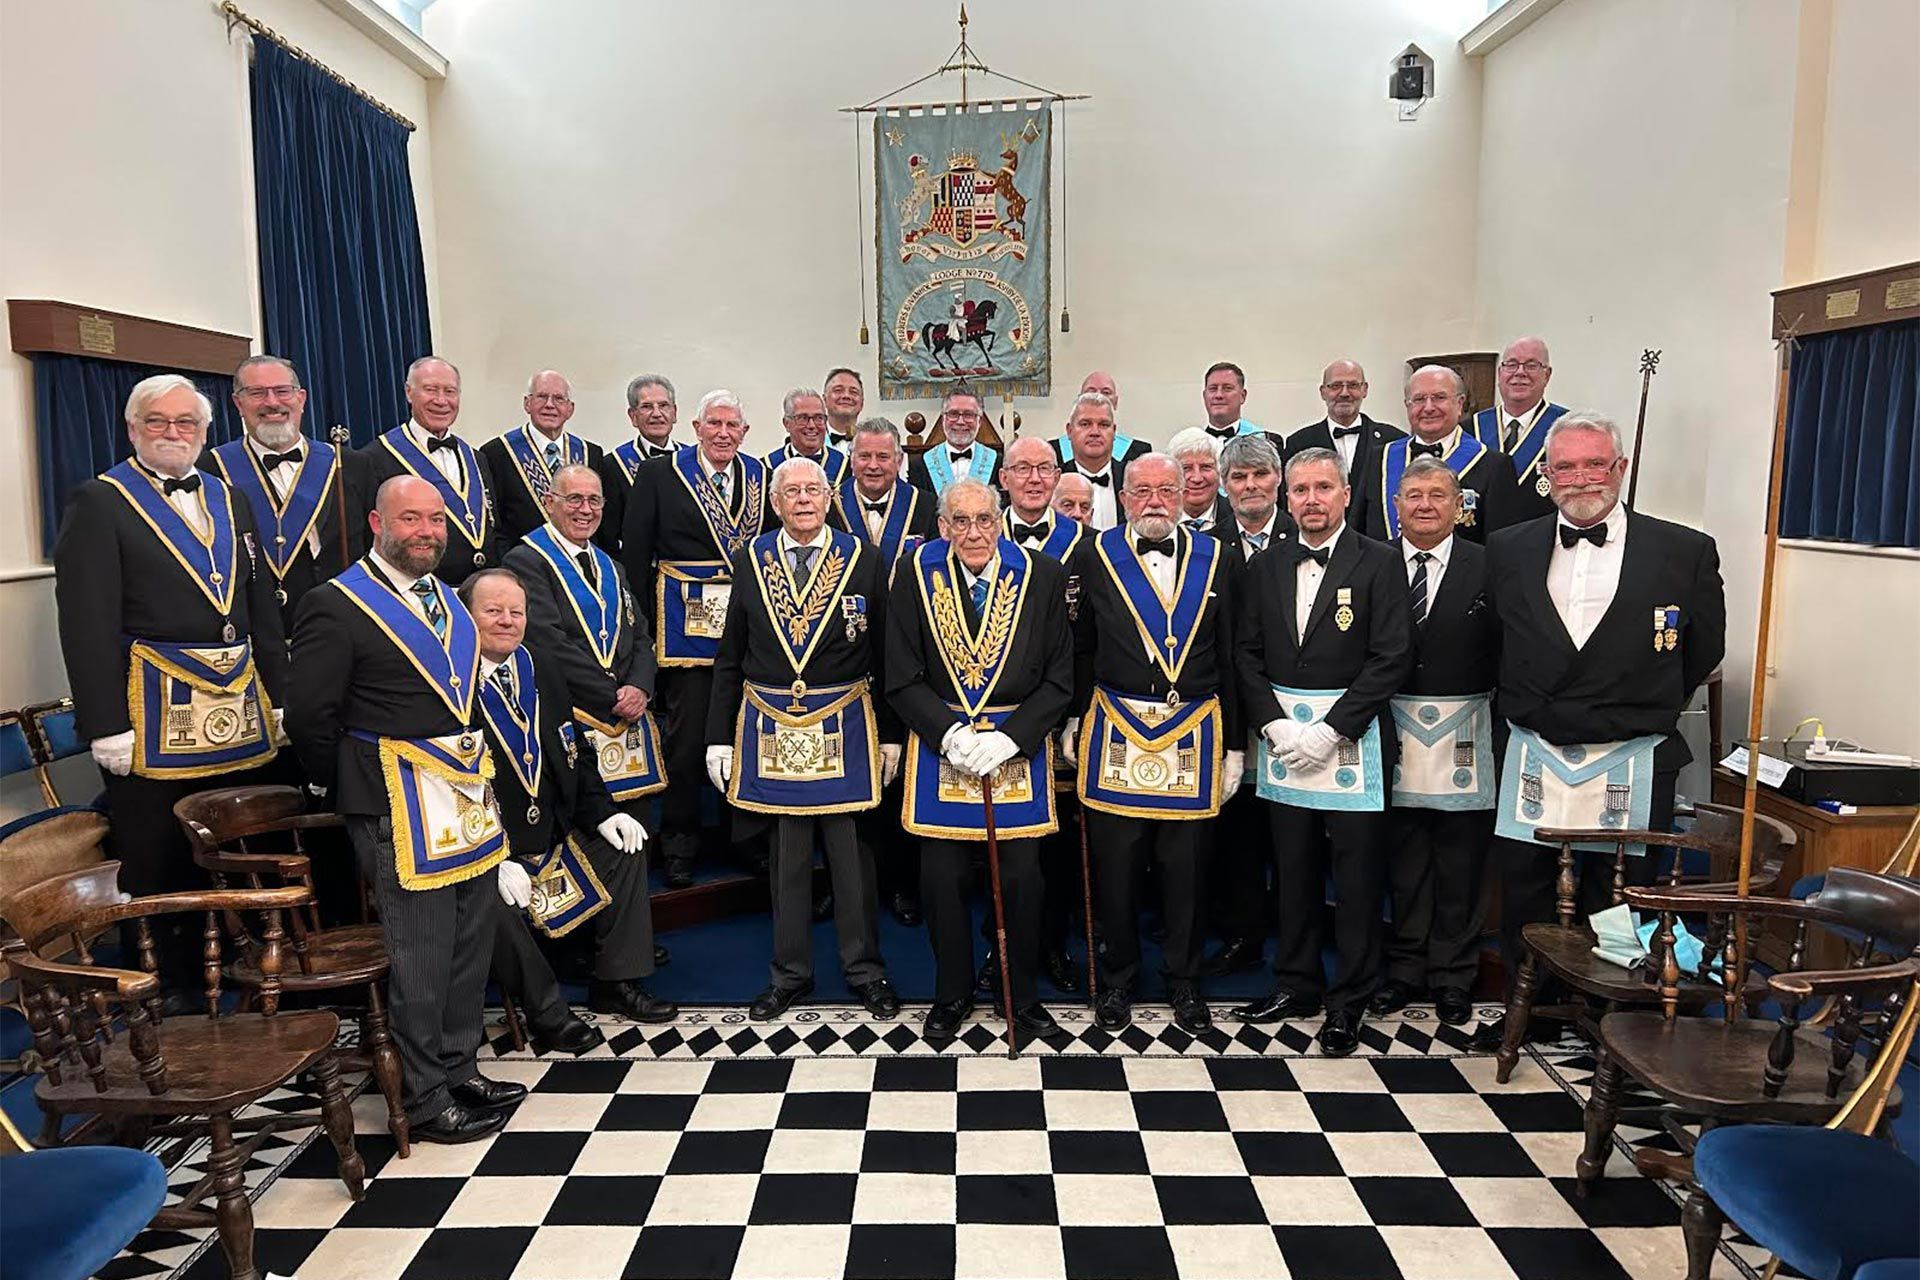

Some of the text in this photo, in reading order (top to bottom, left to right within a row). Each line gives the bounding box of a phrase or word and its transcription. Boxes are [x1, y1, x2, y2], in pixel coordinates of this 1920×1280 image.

[934, 269, 962, 280] LODGE
[977, 270, 994, 279] 779
[996, 281, 1016, 298] ASHBY
[1013, 295, 1022, 306] DE
[1017, 304, 1026, 314] LA
